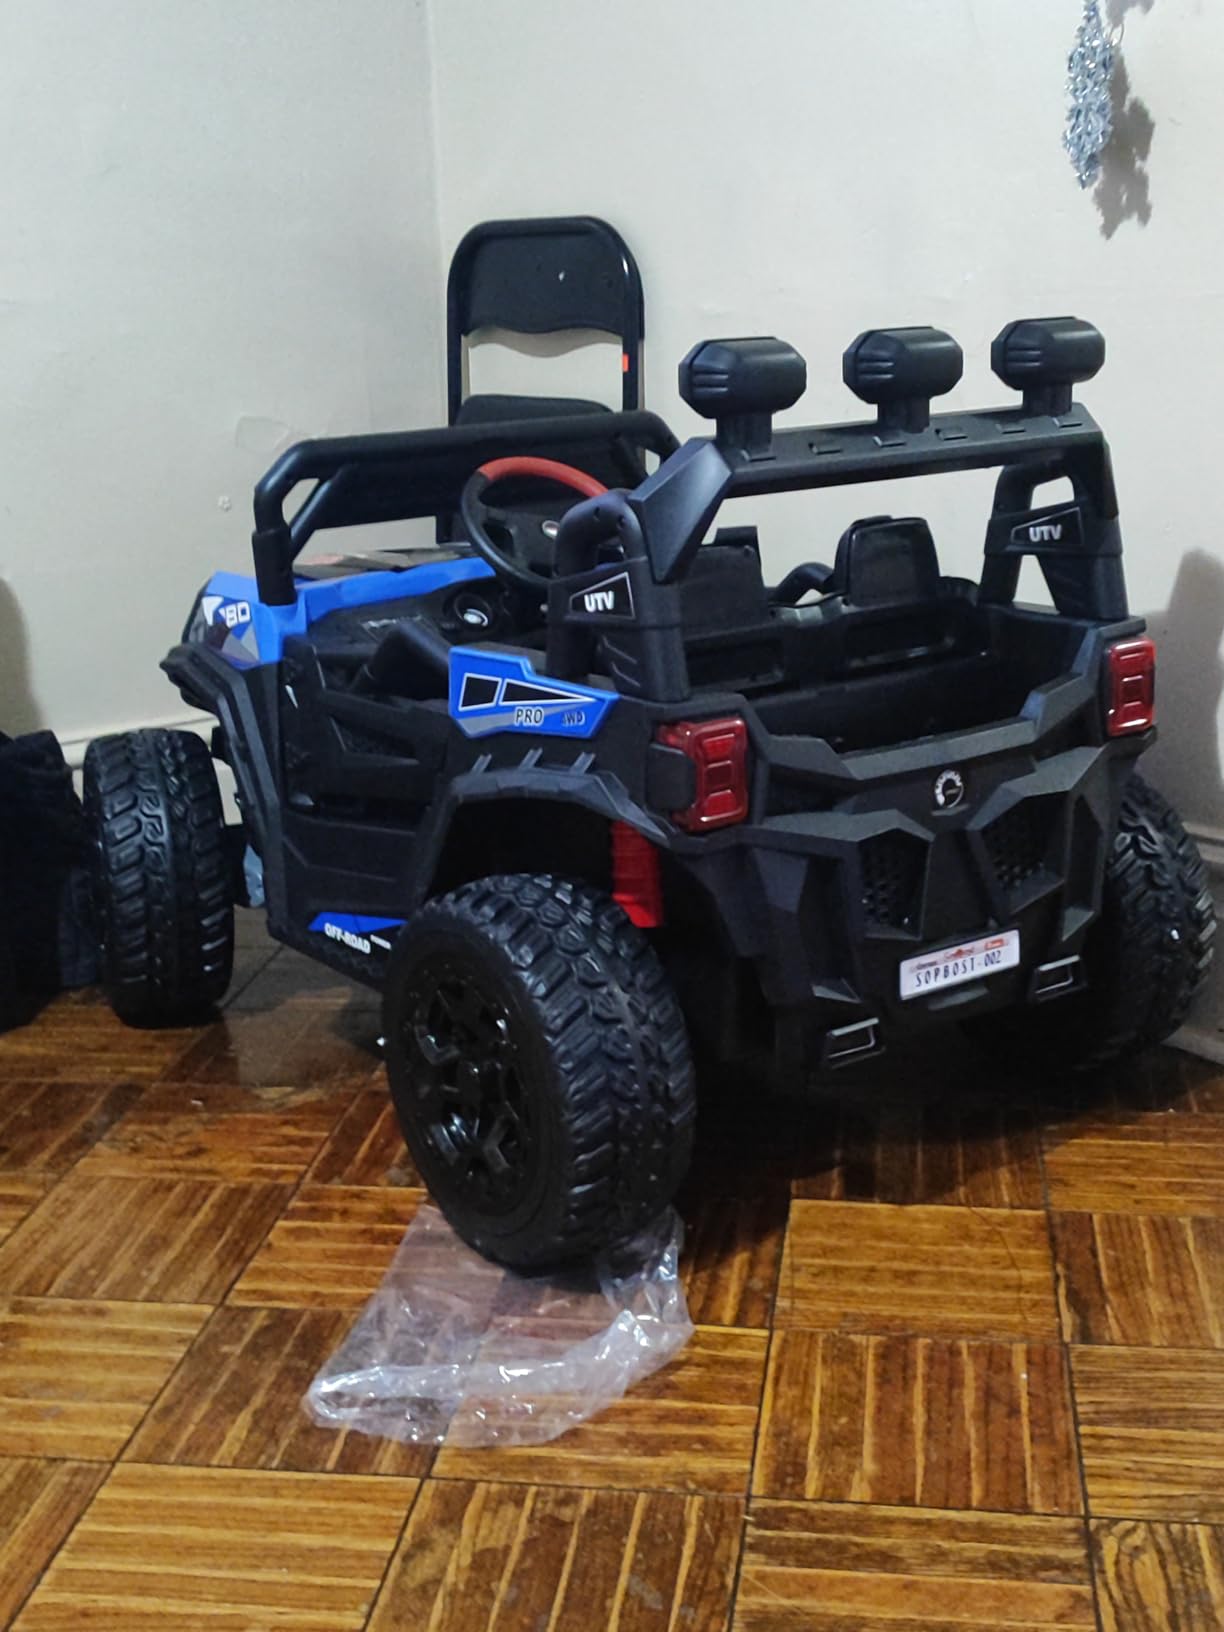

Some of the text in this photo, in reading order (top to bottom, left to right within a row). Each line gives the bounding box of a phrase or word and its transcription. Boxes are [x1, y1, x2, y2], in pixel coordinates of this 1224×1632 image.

[1029, 523, 1062, 543] UTV
[584, 590, 615, 613] UTV
[514, 707, 544, 727] PRO
